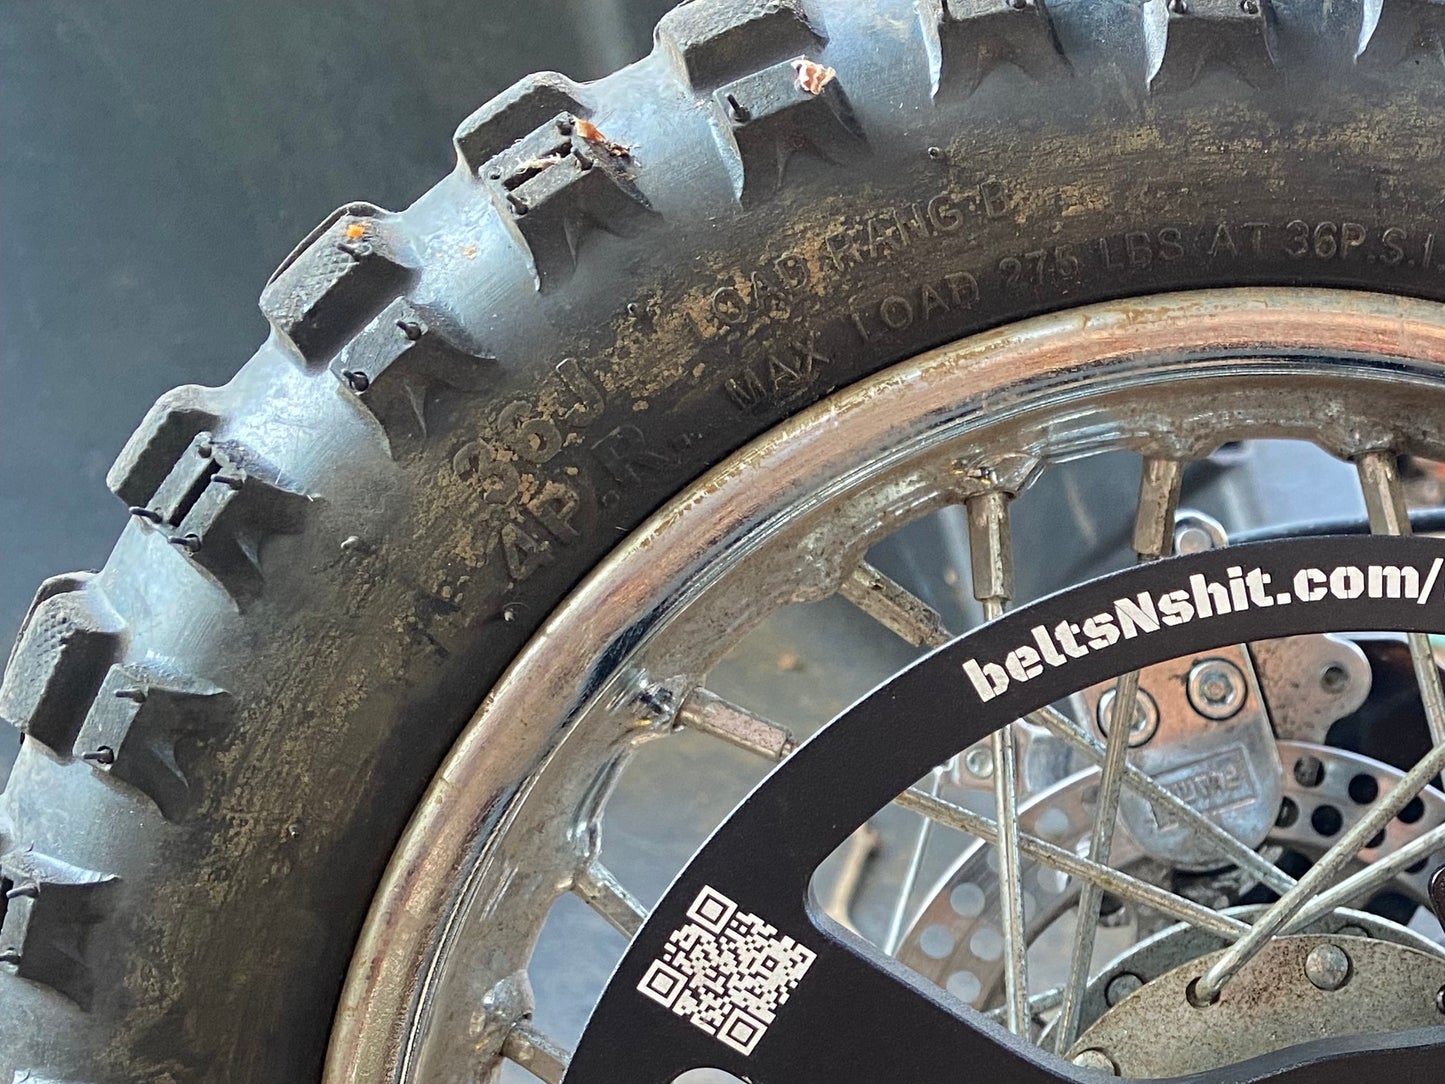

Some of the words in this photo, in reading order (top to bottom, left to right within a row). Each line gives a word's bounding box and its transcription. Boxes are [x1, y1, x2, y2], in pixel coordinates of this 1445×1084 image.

[724, 337, 832, 410] MAX
[849, 270, 980, 343] LOAD
[999, 246, 1081, 289] 275
[1101, 226, 1186, 271] LBS
[1207, 221, 1271, 258] AT
